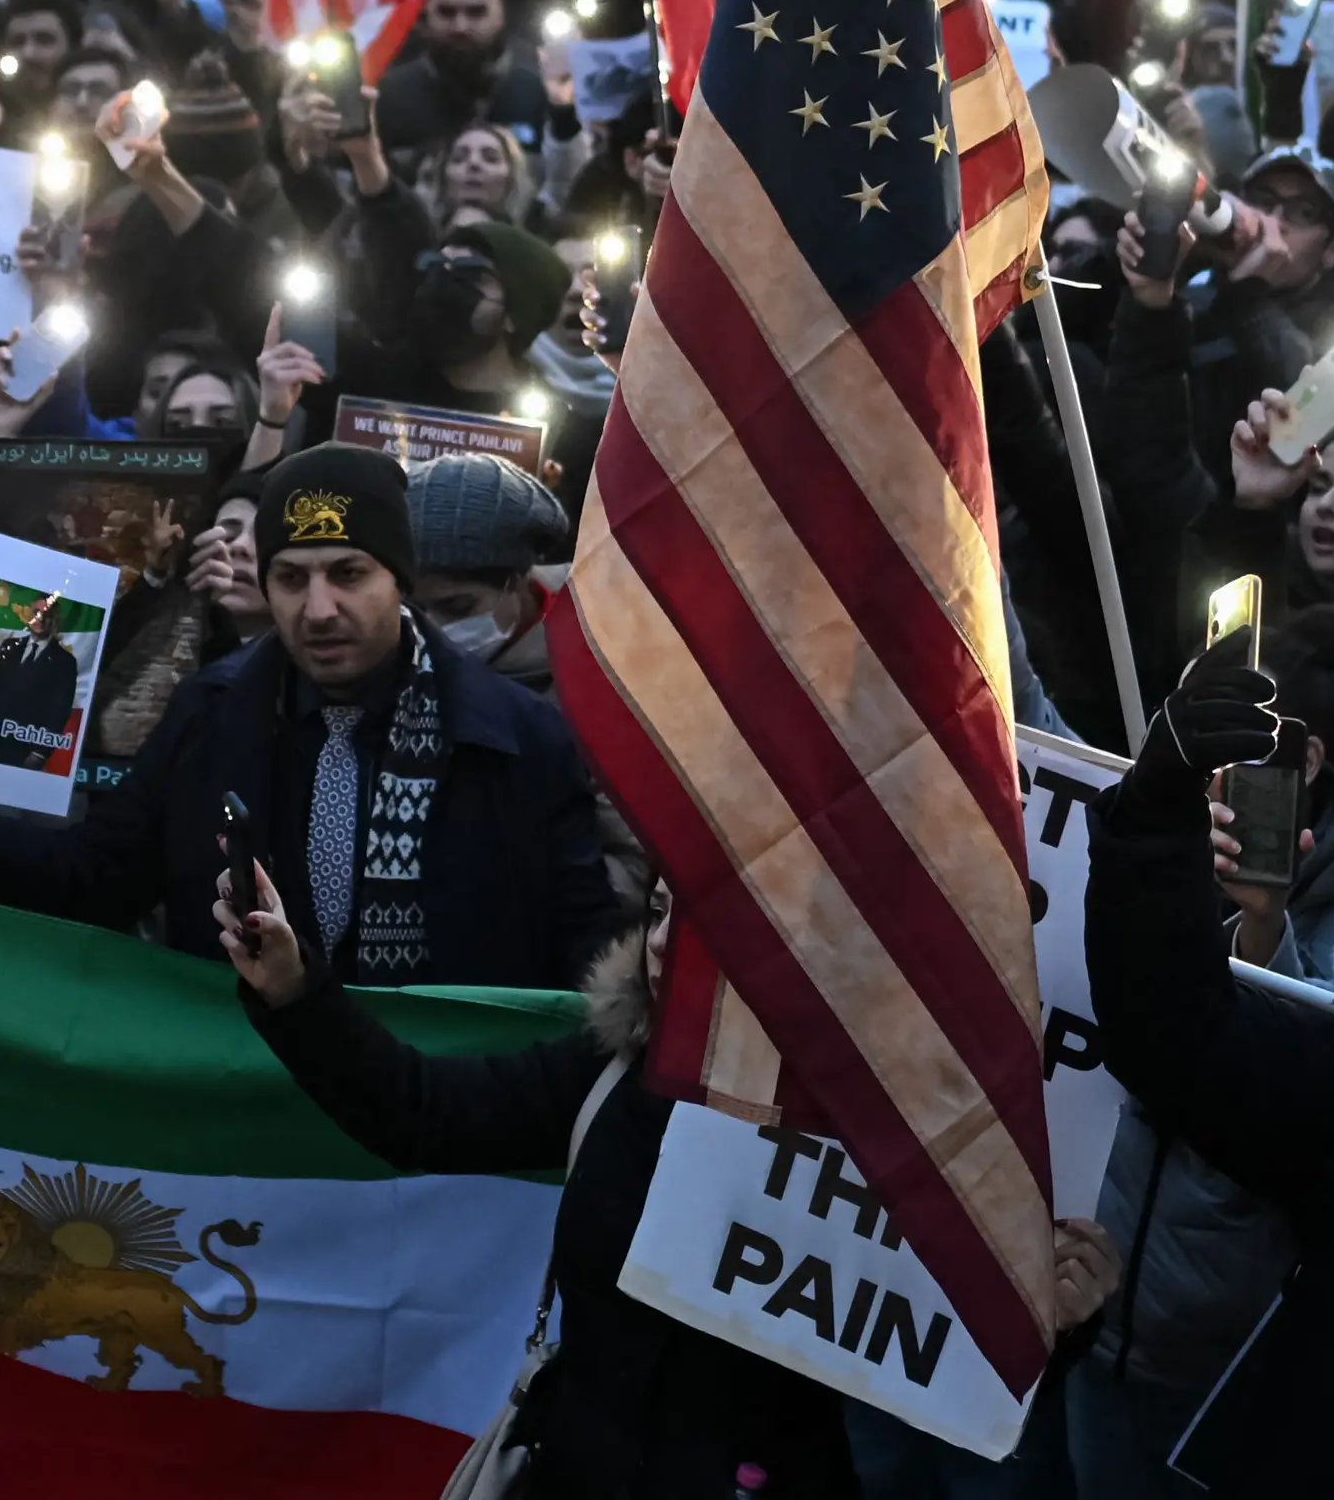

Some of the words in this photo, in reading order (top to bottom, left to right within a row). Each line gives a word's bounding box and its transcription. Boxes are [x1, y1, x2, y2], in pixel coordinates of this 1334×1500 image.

[354, 416, 375, 433] WE
[378, 420, 417, 438] WANT
[419, 425, 465, 445] PRINCE
[469, 431, 524, 453] PAHLAVI
[382, 438, 403, 454] AS
[1, 718, 73, 750] Pahlavi
[758, 1125, 910, 1248] TH
[712, 1221, 952, 1388] PAIN
